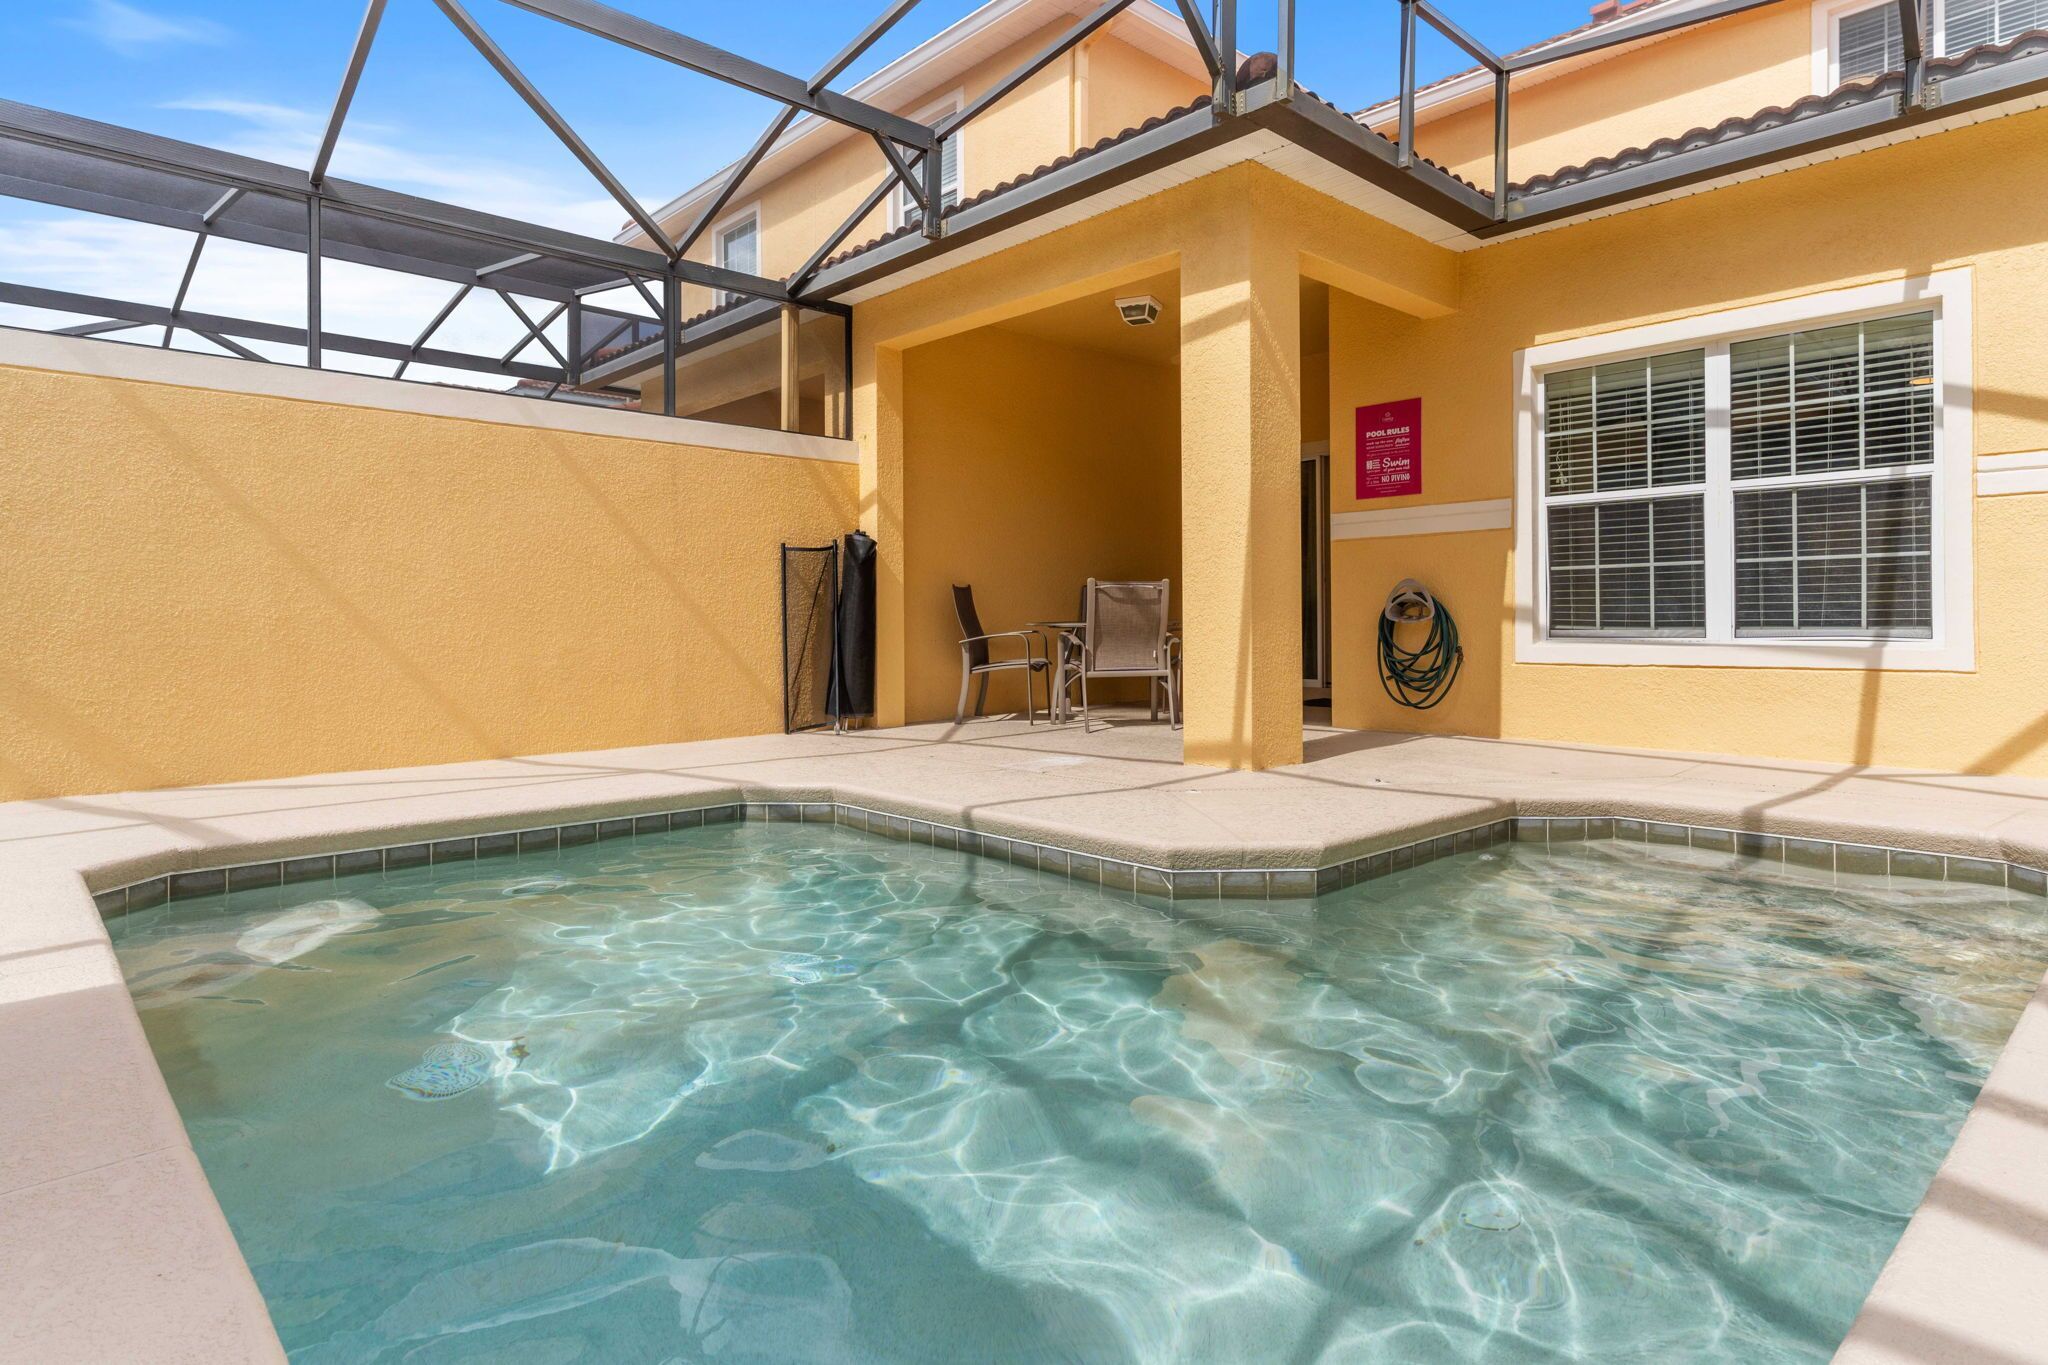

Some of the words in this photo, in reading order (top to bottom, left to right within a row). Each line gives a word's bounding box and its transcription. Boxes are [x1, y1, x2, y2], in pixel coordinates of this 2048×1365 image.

[1366, 430, 1386, 438] POOL
[1387, 426, 1410, 436] RULES
[1382, 457, 1410, 468] Swim
[1381, 475, 1390, 483] NO
[1391, 473, 1410, 482] DIVING
